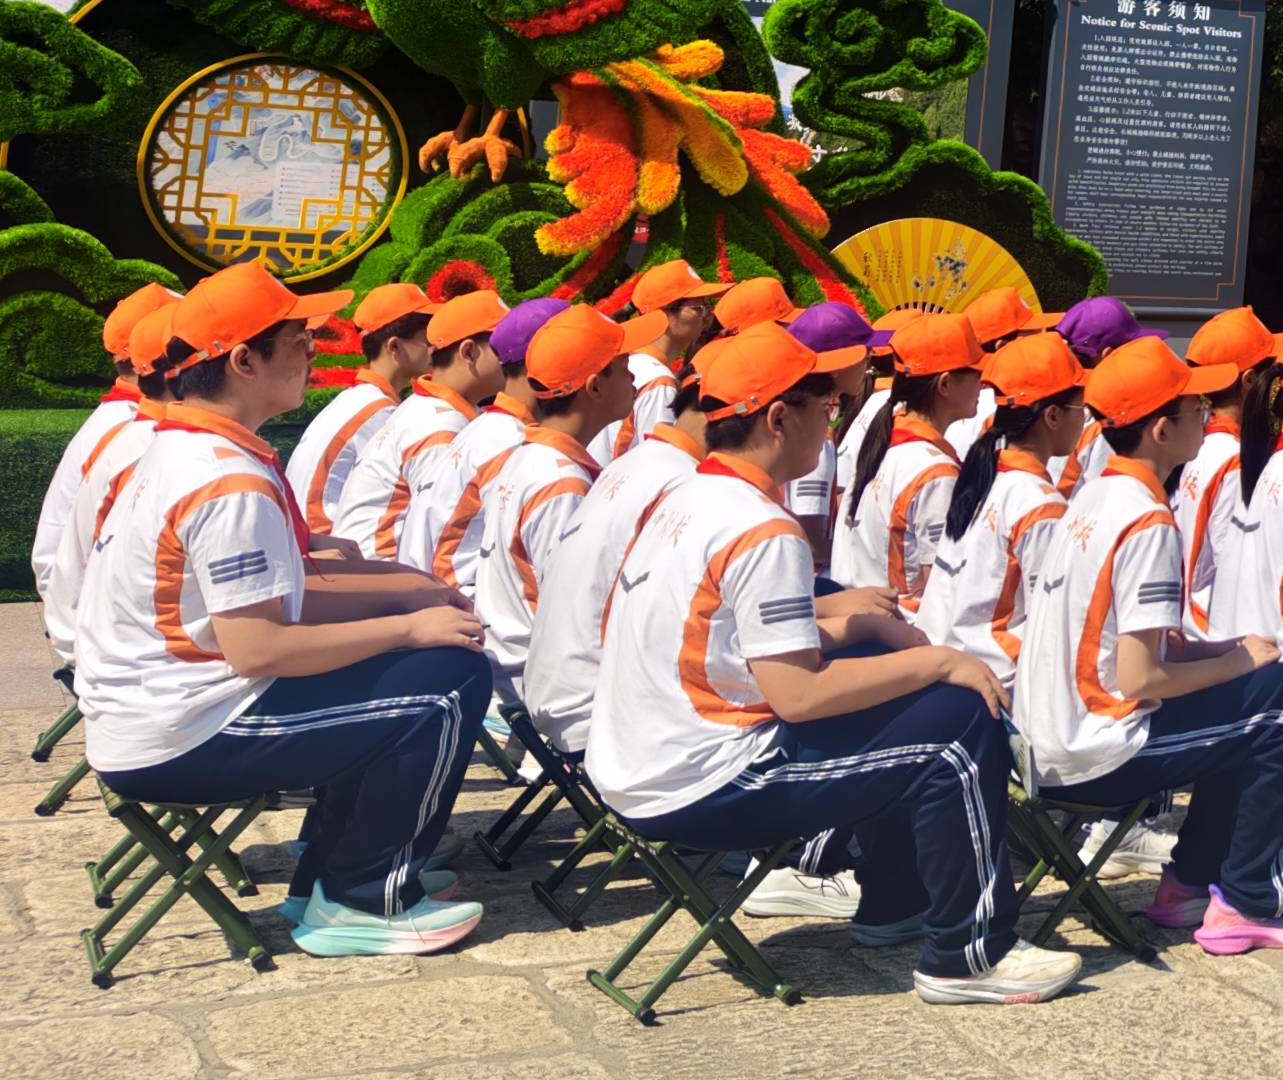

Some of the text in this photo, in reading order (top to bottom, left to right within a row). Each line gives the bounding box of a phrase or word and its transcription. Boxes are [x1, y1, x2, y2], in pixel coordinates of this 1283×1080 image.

[1081, 15, 1242, 39] Notice for Scenic Spot Visitors
